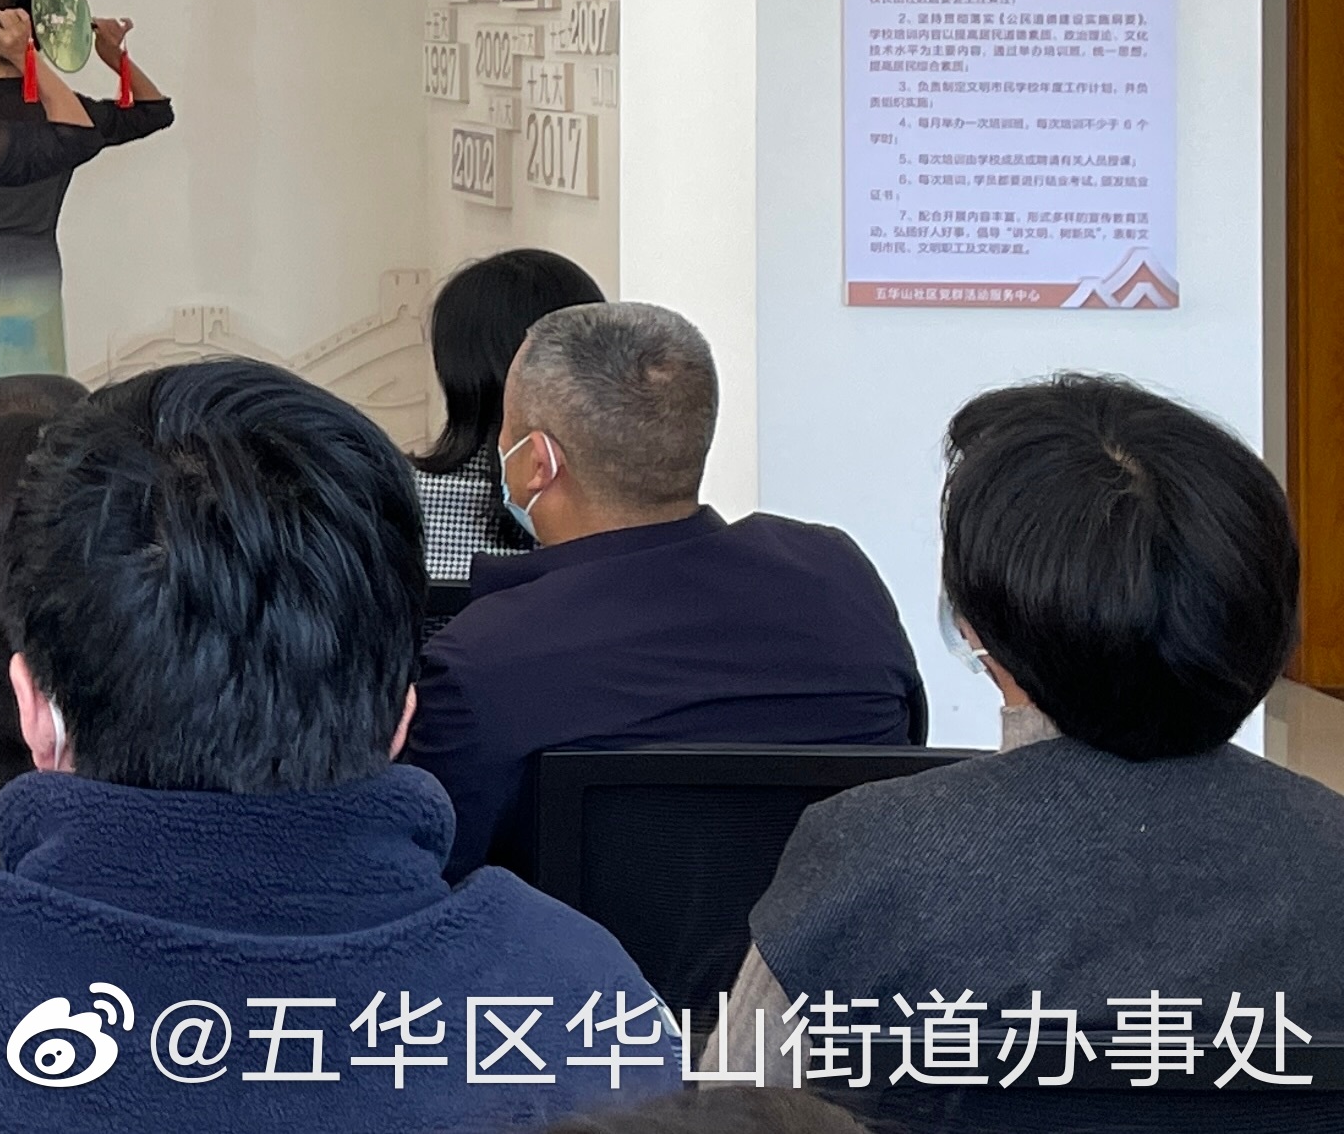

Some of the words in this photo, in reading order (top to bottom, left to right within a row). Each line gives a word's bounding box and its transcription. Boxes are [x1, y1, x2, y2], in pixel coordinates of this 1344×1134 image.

[475, 30, 512, 80] 2002
[570, 1, 609, 56] 2007
[424, 45, 457, 96] 1997
[452, 132, 495, 193] 2012
[526, 112, 582, 190] 2017
